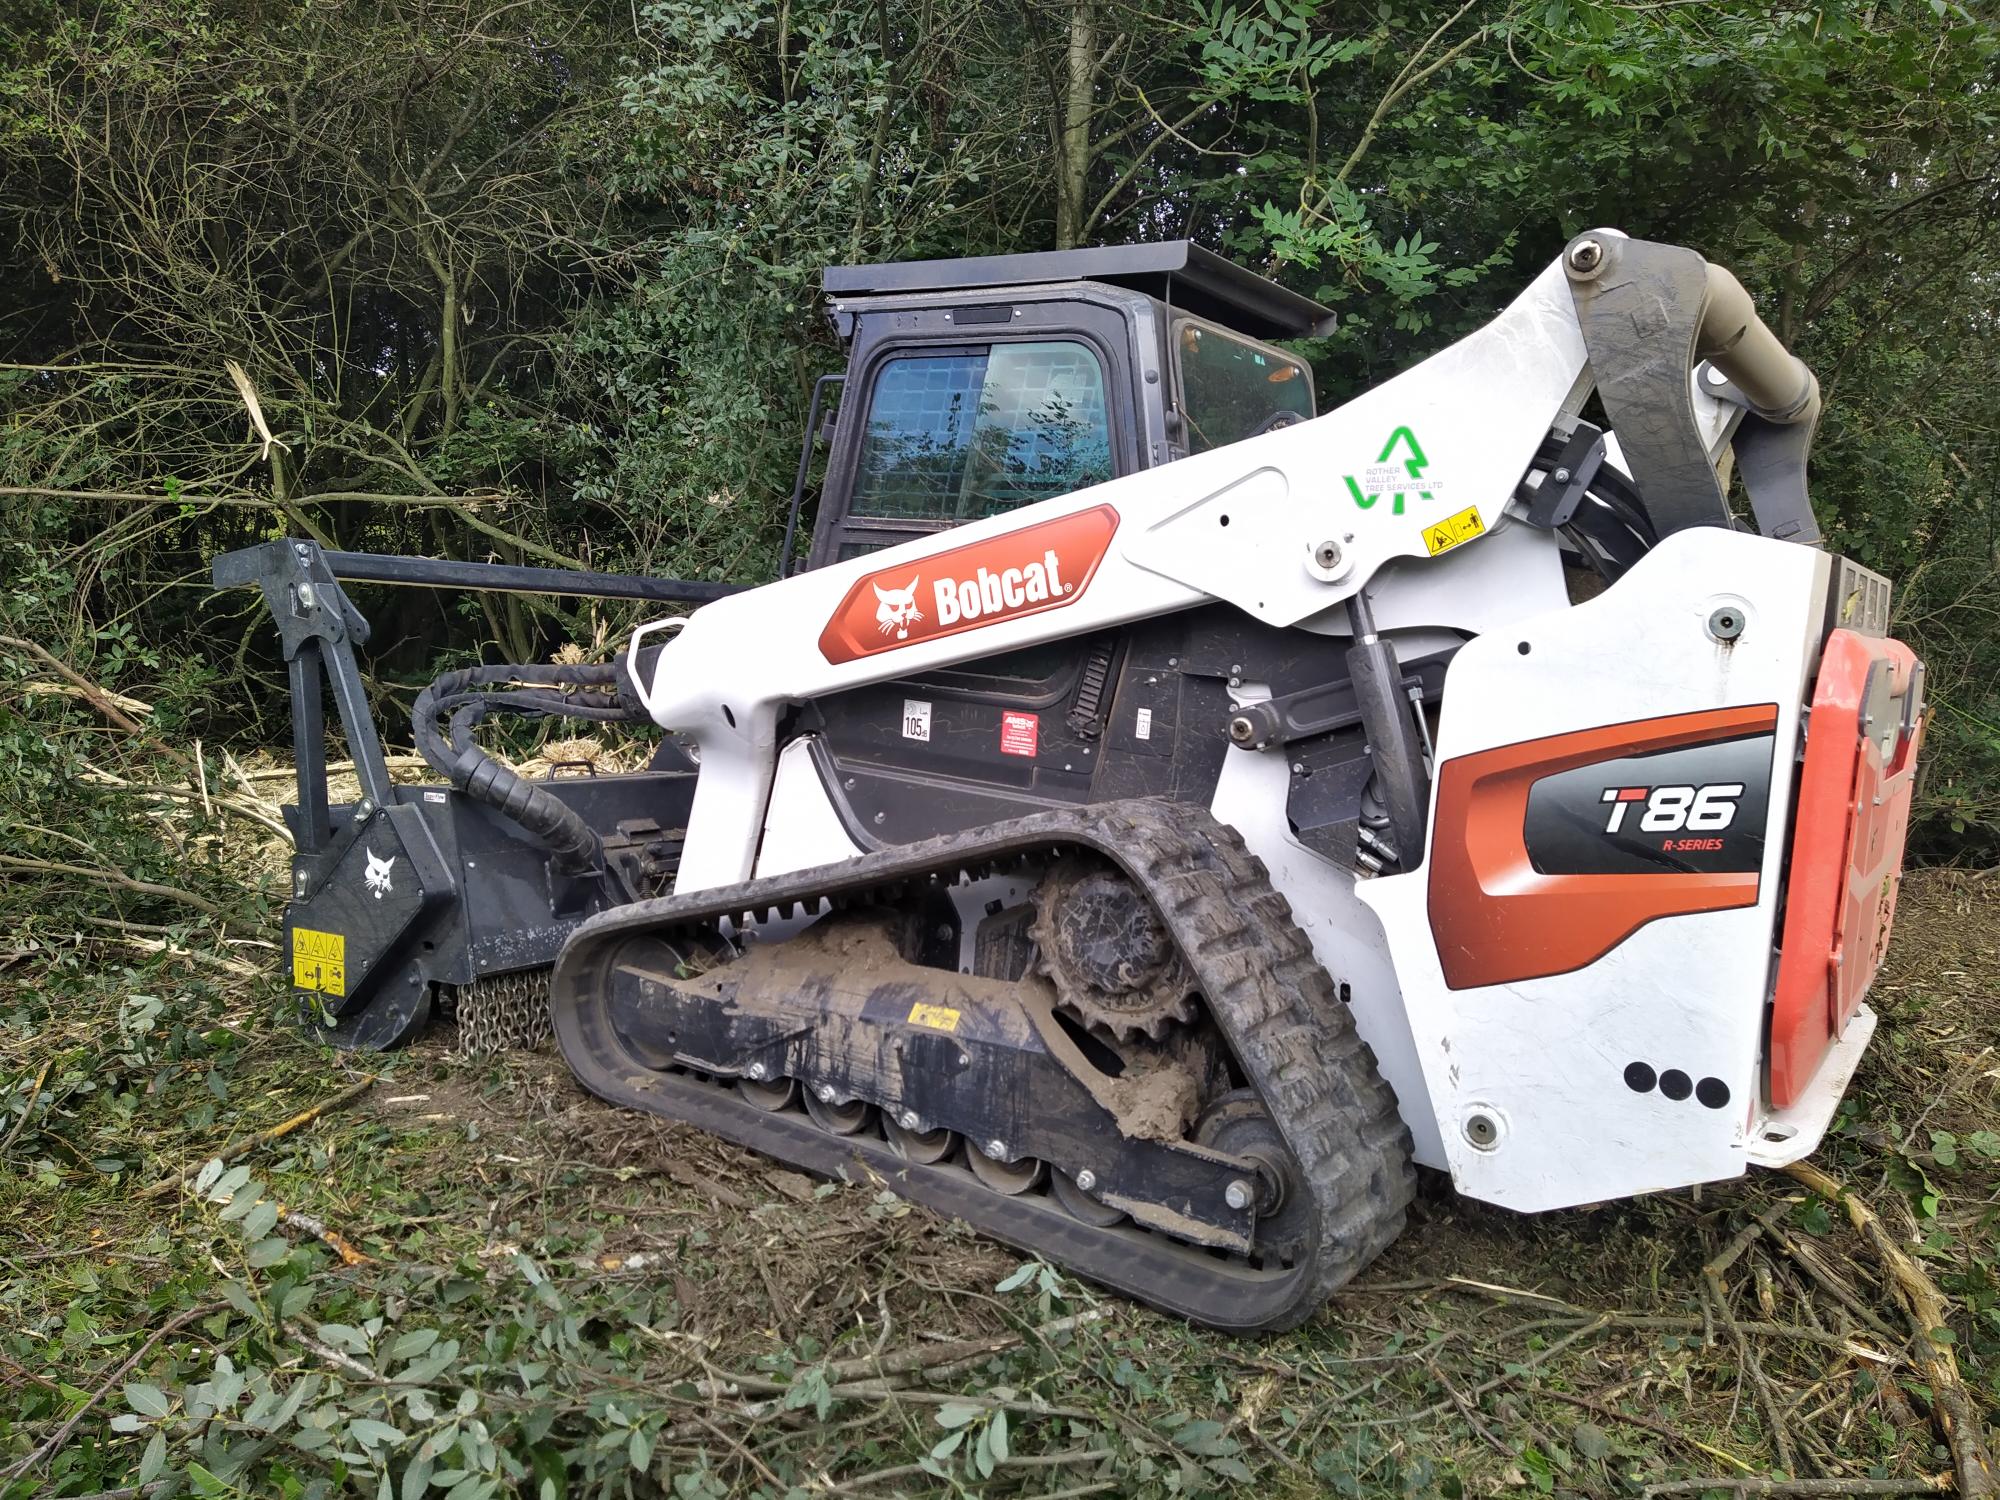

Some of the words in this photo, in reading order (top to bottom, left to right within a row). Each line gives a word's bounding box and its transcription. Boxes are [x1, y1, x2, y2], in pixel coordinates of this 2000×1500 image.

[1366, 466, 1400, 475] ROTHER
[1366, 475, 1397, 484] VALLEY
[1365, 484, 1385, 492] TREE
[1387, 482, 1426, 491] SERVICES
[1428, 481, 1444, 489] LTD
[933, 549, 1064, 626] Bobcat
[905, 716, 922, 736] 105
[1601, 783, 1745, 834] T86
[1663, 838, 1724, 851] R-SERIES
